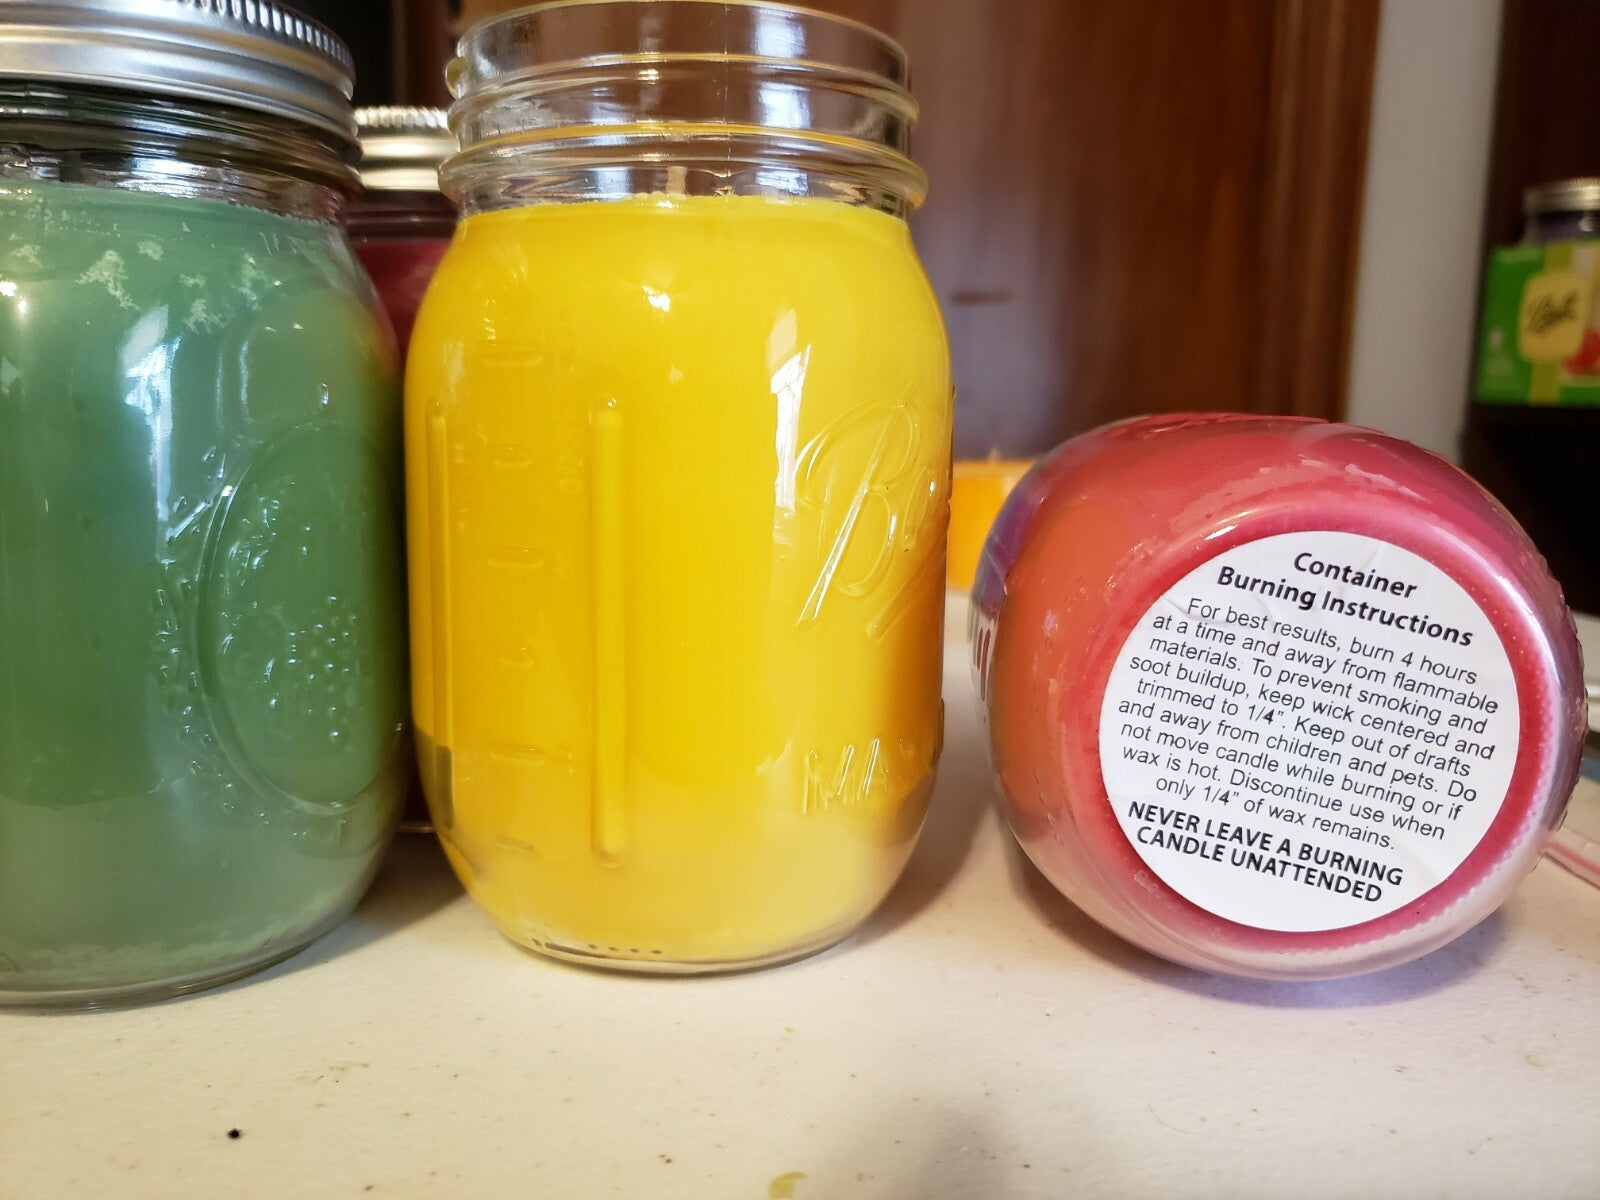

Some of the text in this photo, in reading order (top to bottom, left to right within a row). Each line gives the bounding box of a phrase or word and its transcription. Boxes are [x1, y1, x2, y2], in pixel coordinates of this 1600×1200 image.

[1217, 565, 1475, 647] Burning Instructions
[1294, 552, 1418, 599] Container
[1149, 638, 1488, 735] materials. To prevent smoking and
[1153, 615, 1499, 714] at a time and away from flammable
[1187, 597, 1477, 685] For best results, burn 4 hours
[1118, 700, 1477, 802] and away from children and pets. Do
[1129, 656, 1496, 760] soot buildup, keep wick centered and
[1137, 677, 1216, 711] trimmed
[1221, 697, 1239, 716] to
[1293, 715, 1345, 746] Keep
[1351, 735, 1384, 754] out
[1388, 743, 1411, 760] of
[1414, 749, 1471, 777] drafts
[1121, 723, 1464, 821] not move candle while burning or if
[1123, 746, 1445, 840] wax is hot. Discontinue use when
[1156, 778, 1196, 801] only
[1243, 798, 1265, 814] of
[1269, 805, 1307, 826] wax
[1312, 816, 1394, 850] remains.
[1128, 801, 1404, 886] NEVER LEAVE A BURNING
[1137, 826, 1382, 902] CANDLE UNATTENDED
